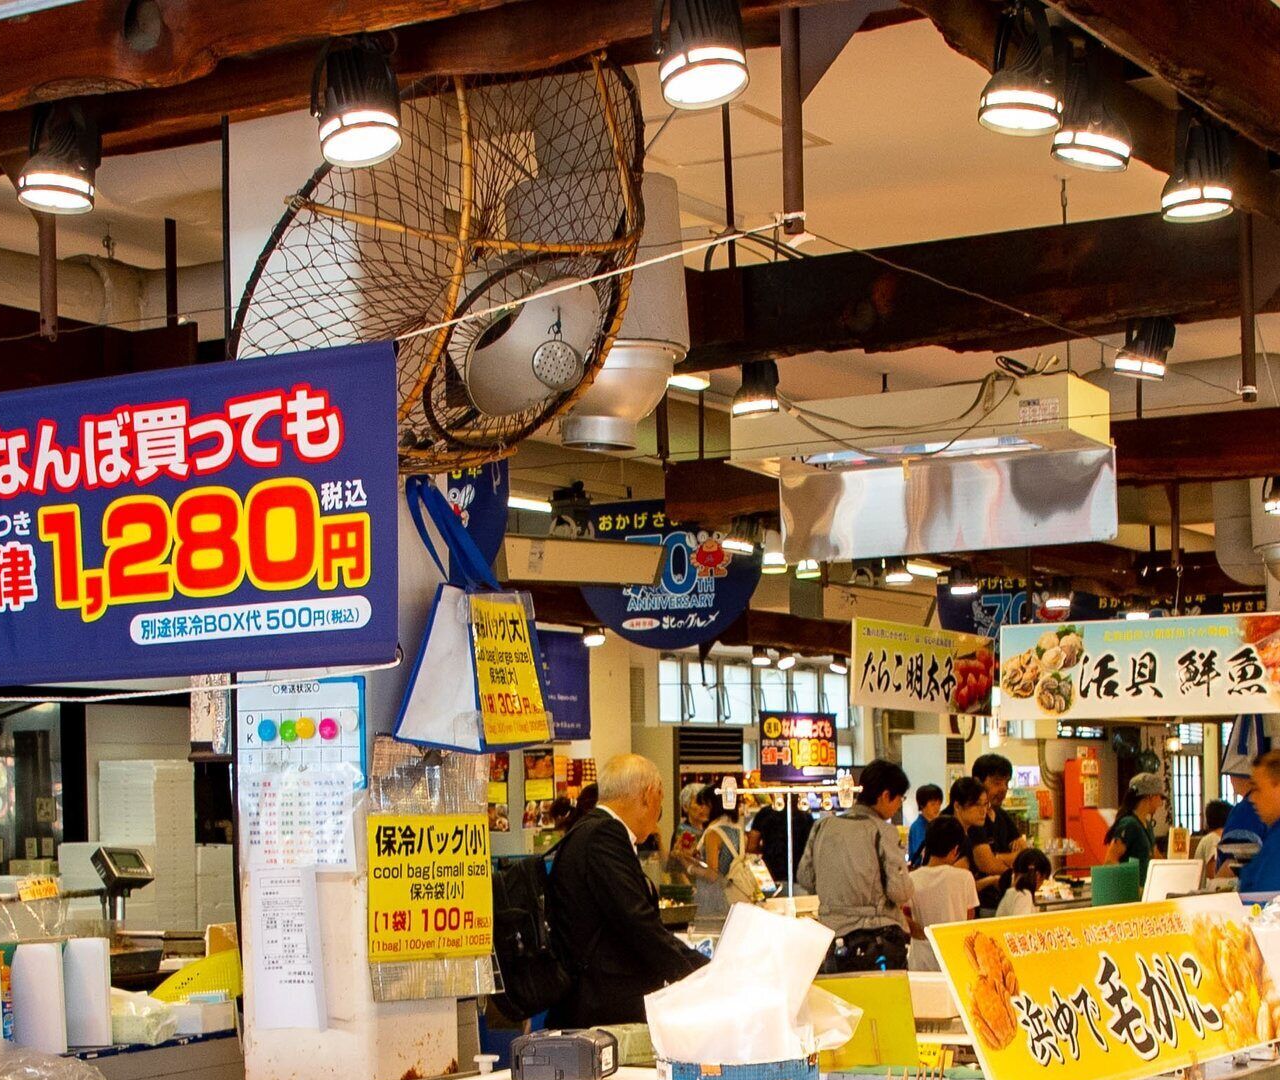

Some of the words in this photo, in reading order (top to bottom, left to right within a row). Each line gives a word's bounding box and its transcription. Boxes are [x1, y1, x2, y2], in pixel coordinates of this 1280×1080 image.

[321, 480, 368, 511] 税込
[626, 593, 716, 612] ANNIVERSARY
[860, 650, 957, 703] たらこ明太子
[374, 863, 403, 879] cool
[1014, 951, 1224, 1067] 浜ゆで毛がに
